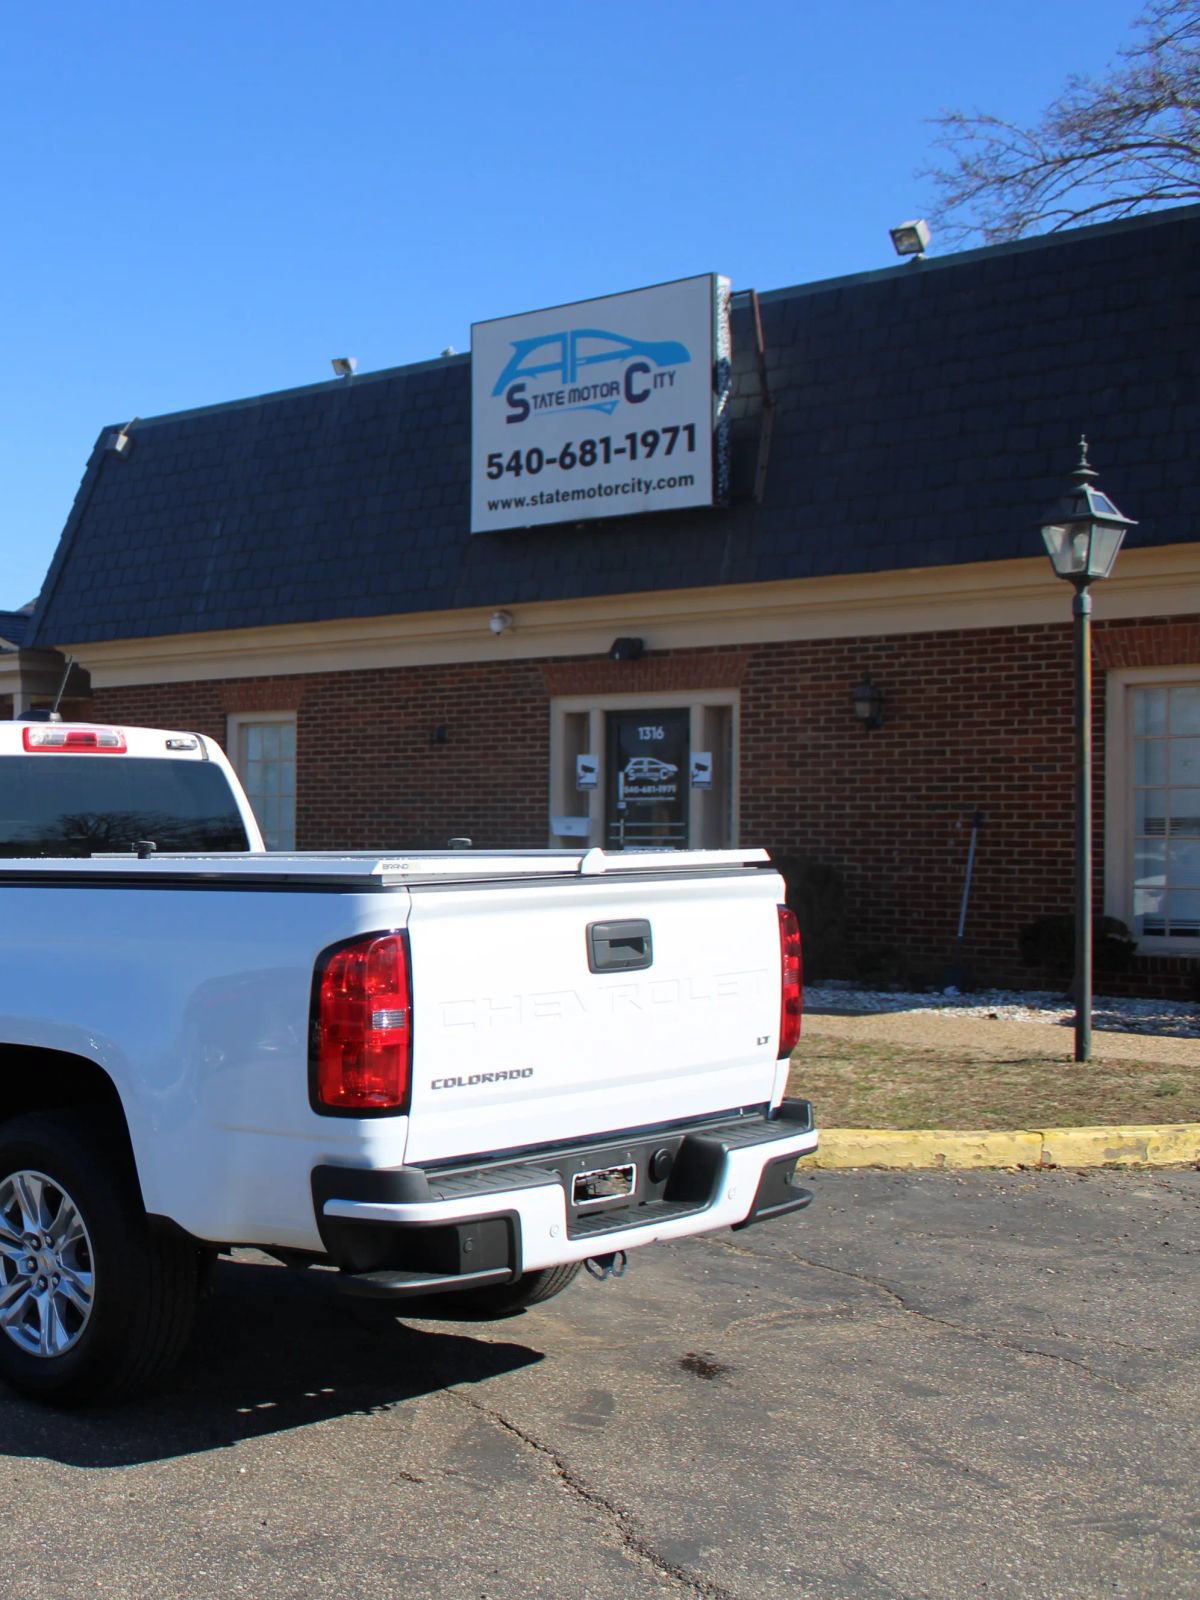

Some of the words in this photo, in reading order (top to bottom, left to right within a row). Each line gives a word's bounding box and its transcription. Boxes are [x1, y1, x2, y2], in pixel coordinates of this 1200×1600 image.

[506, 383, 565, 424] STATE
[569, 381, 620, 405] MOTOR
[625, 362, 676, 404] CITY
[487, 423, 696, 480] 540-681-1971
[488, 472, 695, 511] www.statemotorcity.com
[638, 726, 665, 741] 1316
[438, 968, 769, 1030] CHEVROLET
[757, 1035, 771, 1046] LT
[431, 1067, 534, 1090] COLORADO
